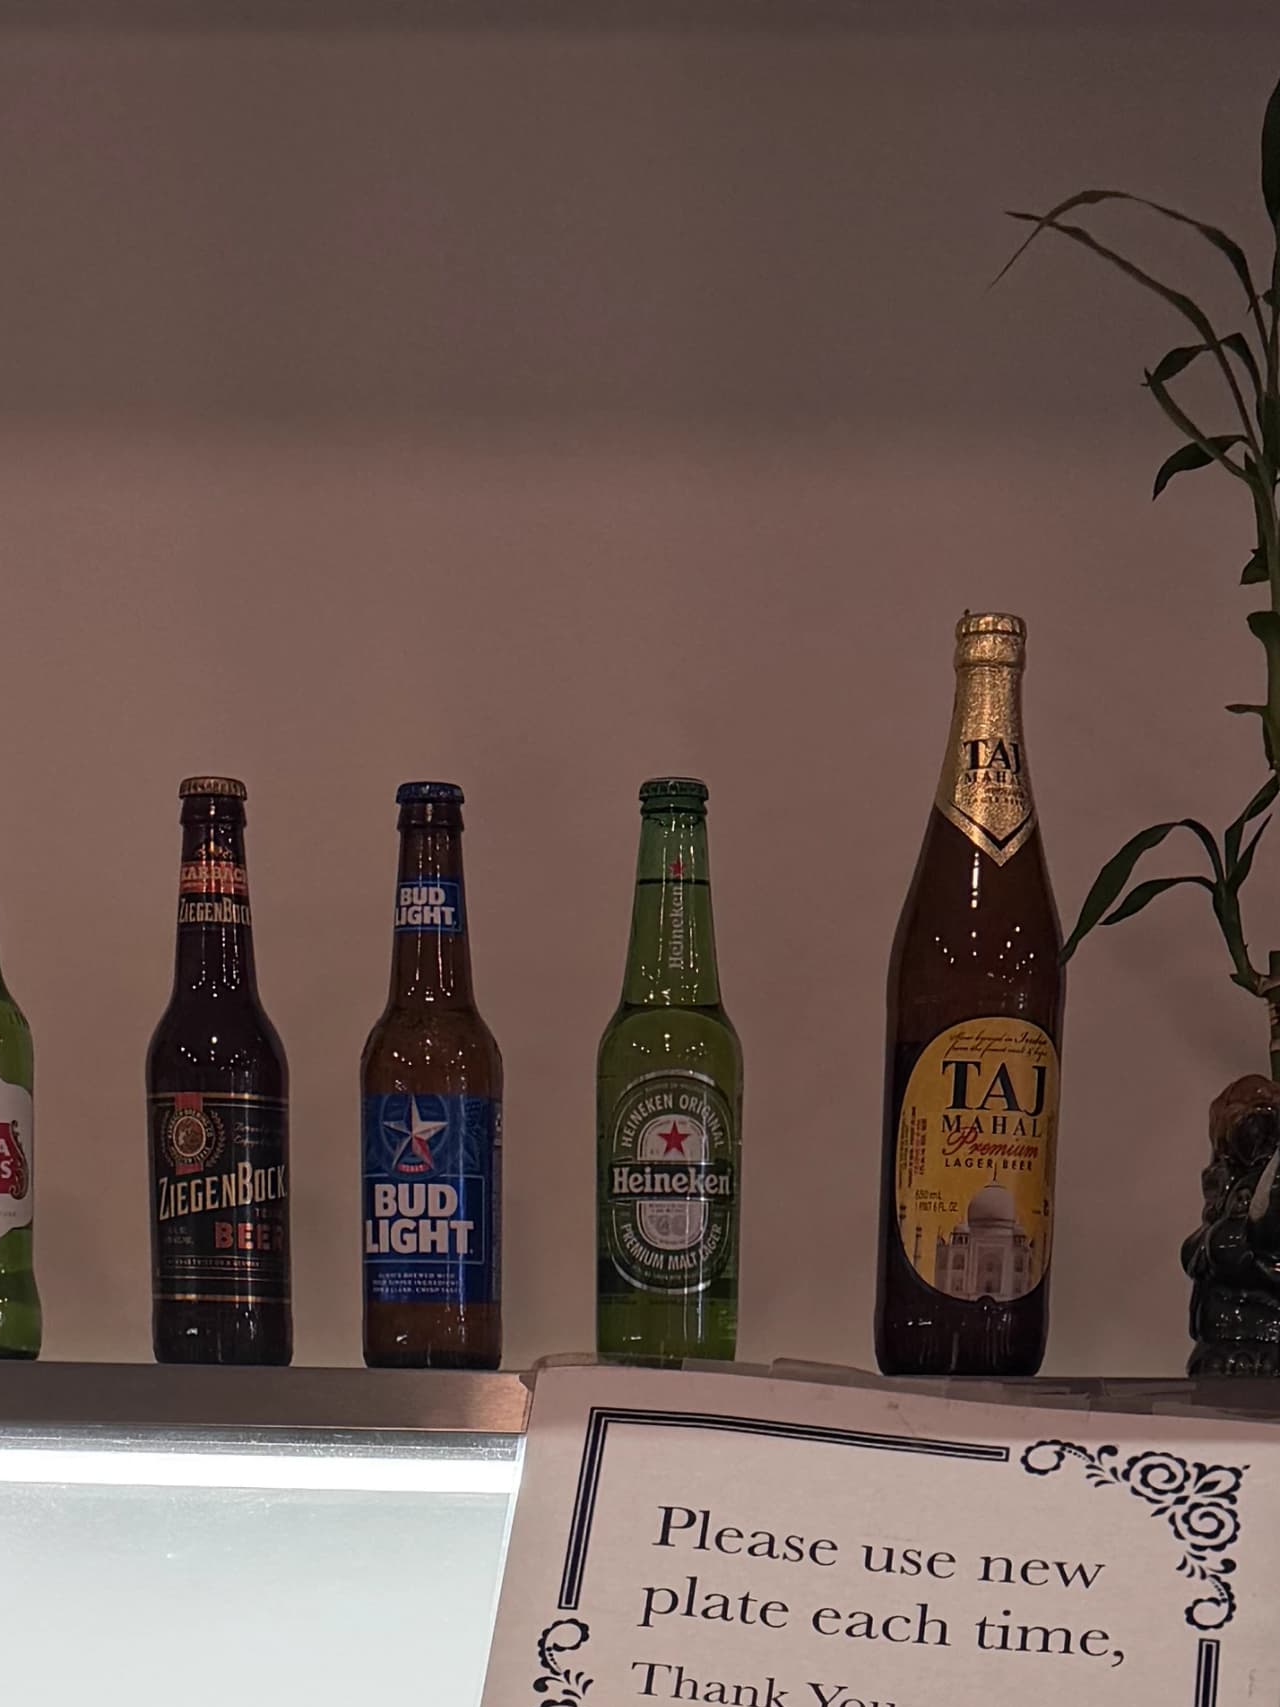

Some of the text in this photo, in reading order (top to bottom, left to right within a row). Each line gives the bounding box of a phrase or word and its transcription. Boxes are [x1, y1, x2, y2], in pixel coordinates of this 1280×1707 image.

[963, 738, 1020, 774] TAJ
[400, 887, 445, 905] BUD
[396, 906, 455, 926] LIGHT
[668, 886, 684, 968] Heineken
[942, 1060, 1047, 1116] TAJ
[620, 1093, 725, 1148] HEINEKEN ORIGINAL
[942, 1115, 1042, 1137] MAHAL
[942, 1126, 1040, 1159] Premium
[612, 1166, 732, 1195] Heineken
[944, 1158, 1033, 1172] LAGER BEER
[374, 1183, 458, 1218] BUD
[215, 1221, 285, 1251] BEER
[365, 1218, 475, 1254] LIGHT
[621, 1222, 665, 1268] PREMIUM
[668, 1252, 698, 1270] MALT
[652, 1505, 1107, 1592] Please use new
[638, 1576, 1127, 1667] plate each time,
